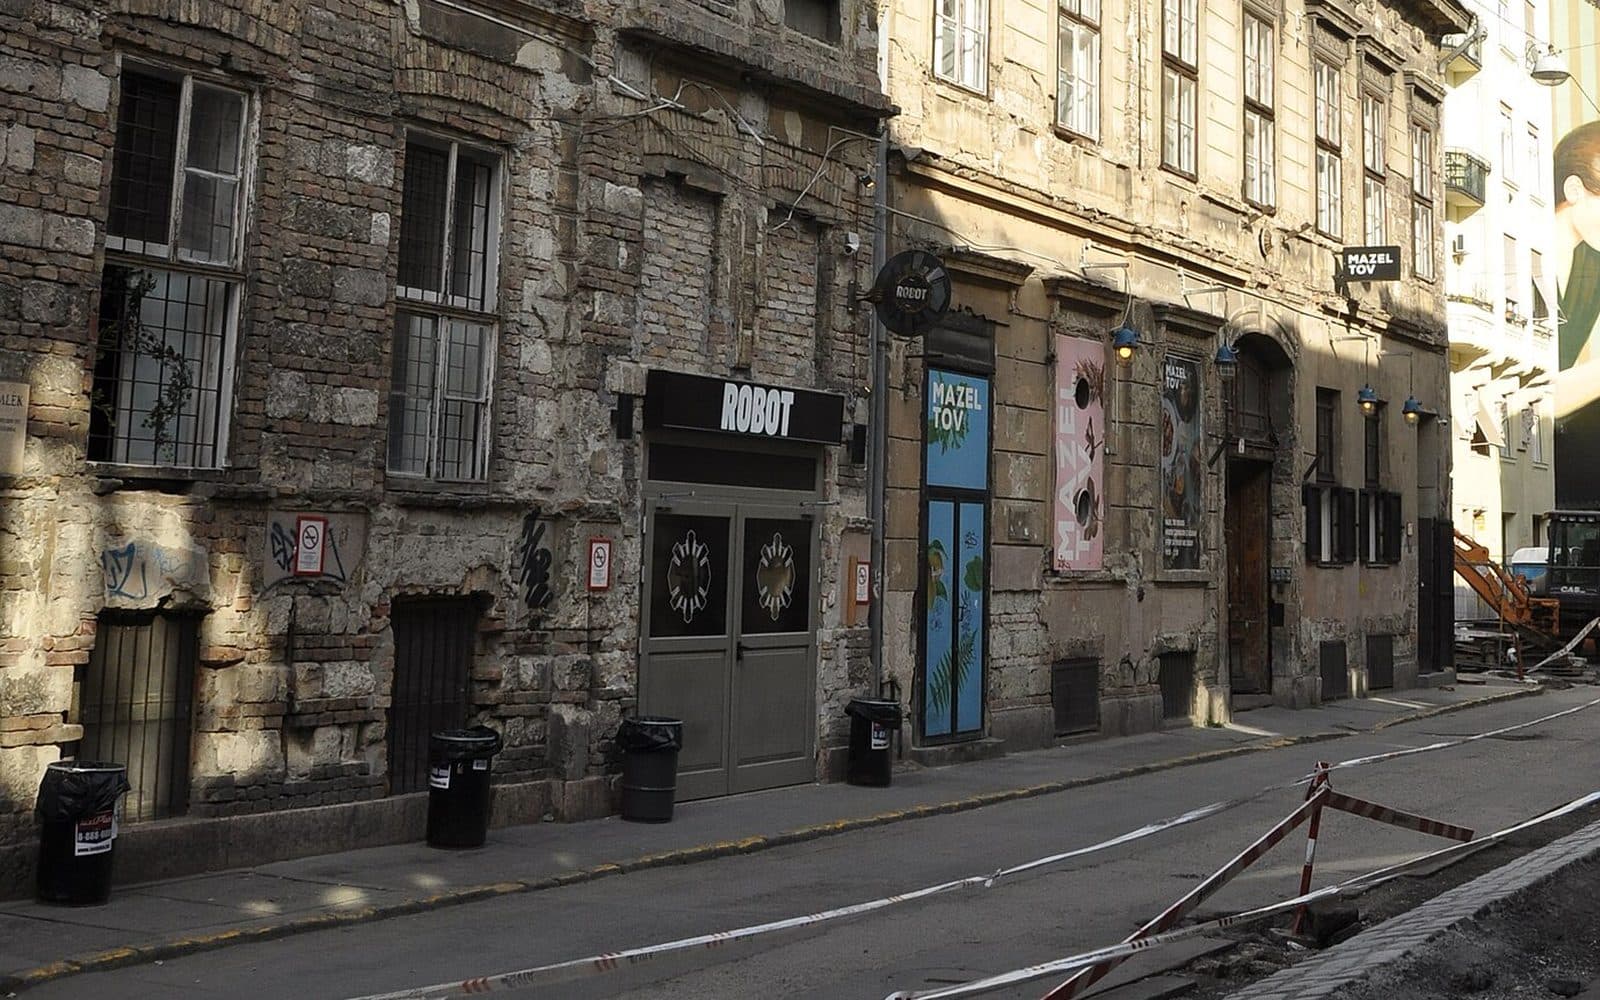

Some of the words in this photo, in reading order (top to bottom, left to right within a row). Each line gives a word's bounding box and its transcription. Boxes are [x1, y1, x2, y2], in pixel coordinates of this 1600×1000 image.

[1347, 253, 1394, 264] MAZEL
[1347, 264, 1376, 275] TOV
[896, 285, 928, 300] ROBOT
[1165, 363, 1187, 379] MAZEL
[1166, 376, 1180, 390] TOV
[932, 381, 982, 411] MAZEL
[720, 382, 794, 437] ROBOT
[932, 406, 965, 432] TOV
[1057, 373, 1077, 562] MAZEL
